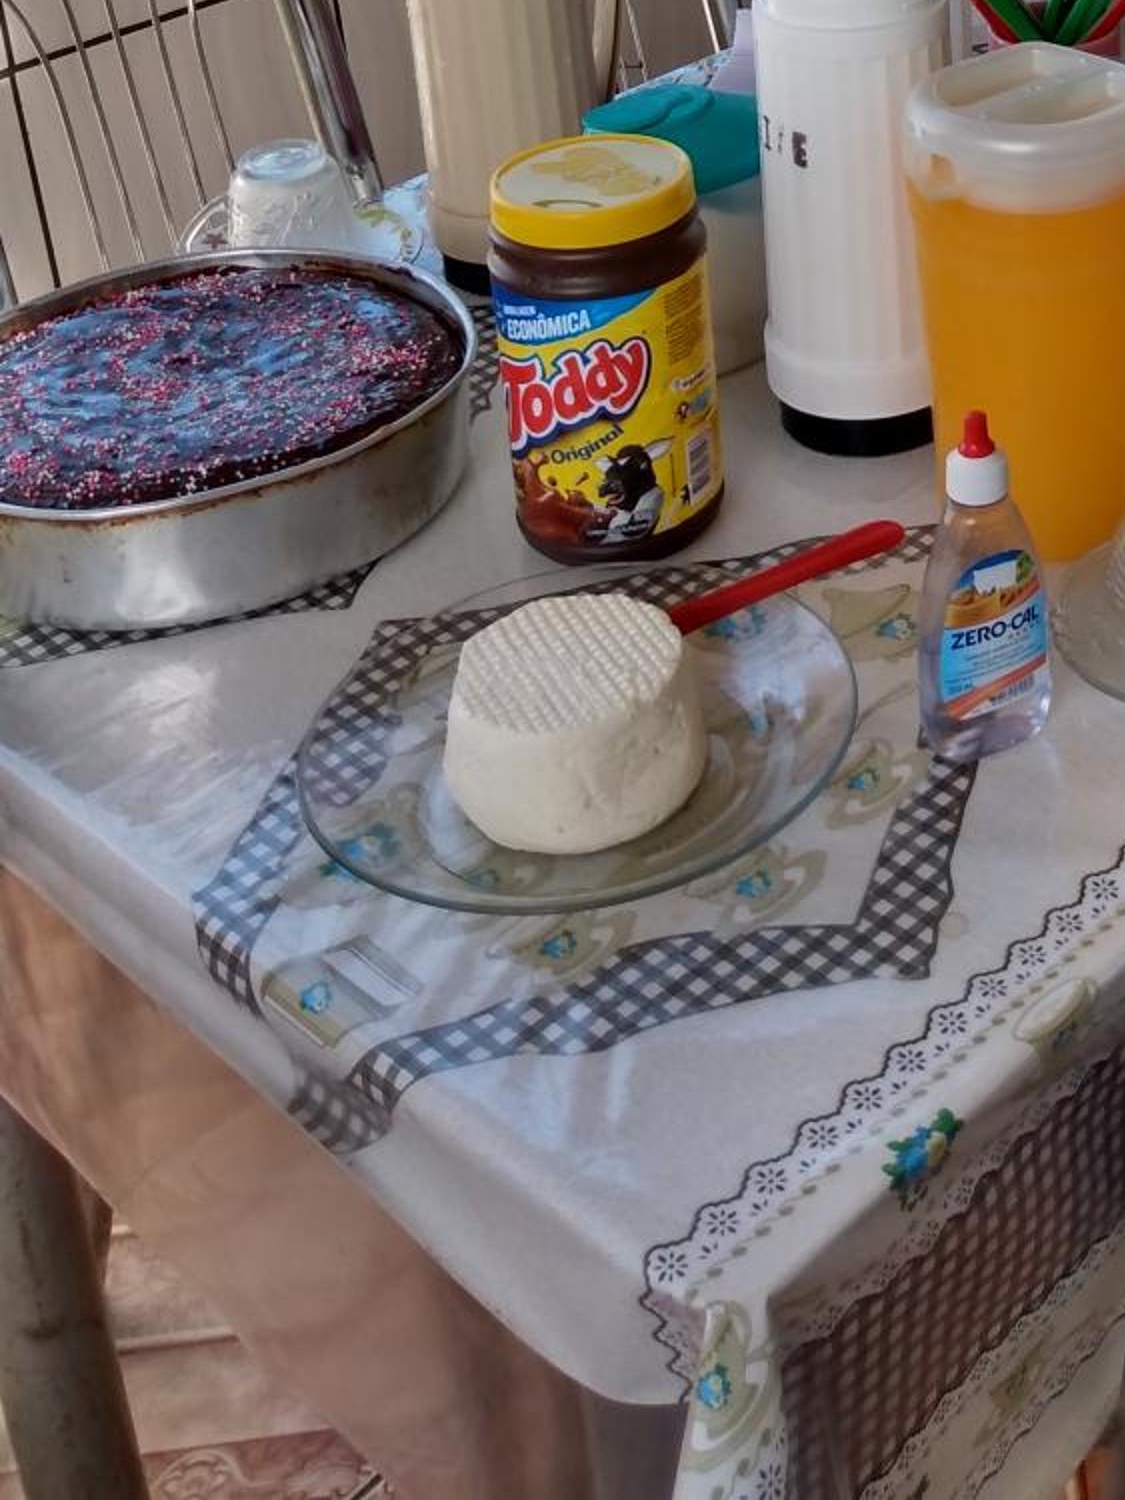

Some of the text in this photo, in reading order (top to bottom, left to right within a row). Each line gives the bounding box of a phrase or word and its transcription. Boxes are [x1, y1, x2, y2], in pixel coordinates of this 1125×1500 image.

[507, 308, 591, 340] ECONÔMICA
[501, 341, 649, 447] Toddy
[551, 424, 625, 464] Original
[951, 603, 1040, 650] ZERO-CAL
